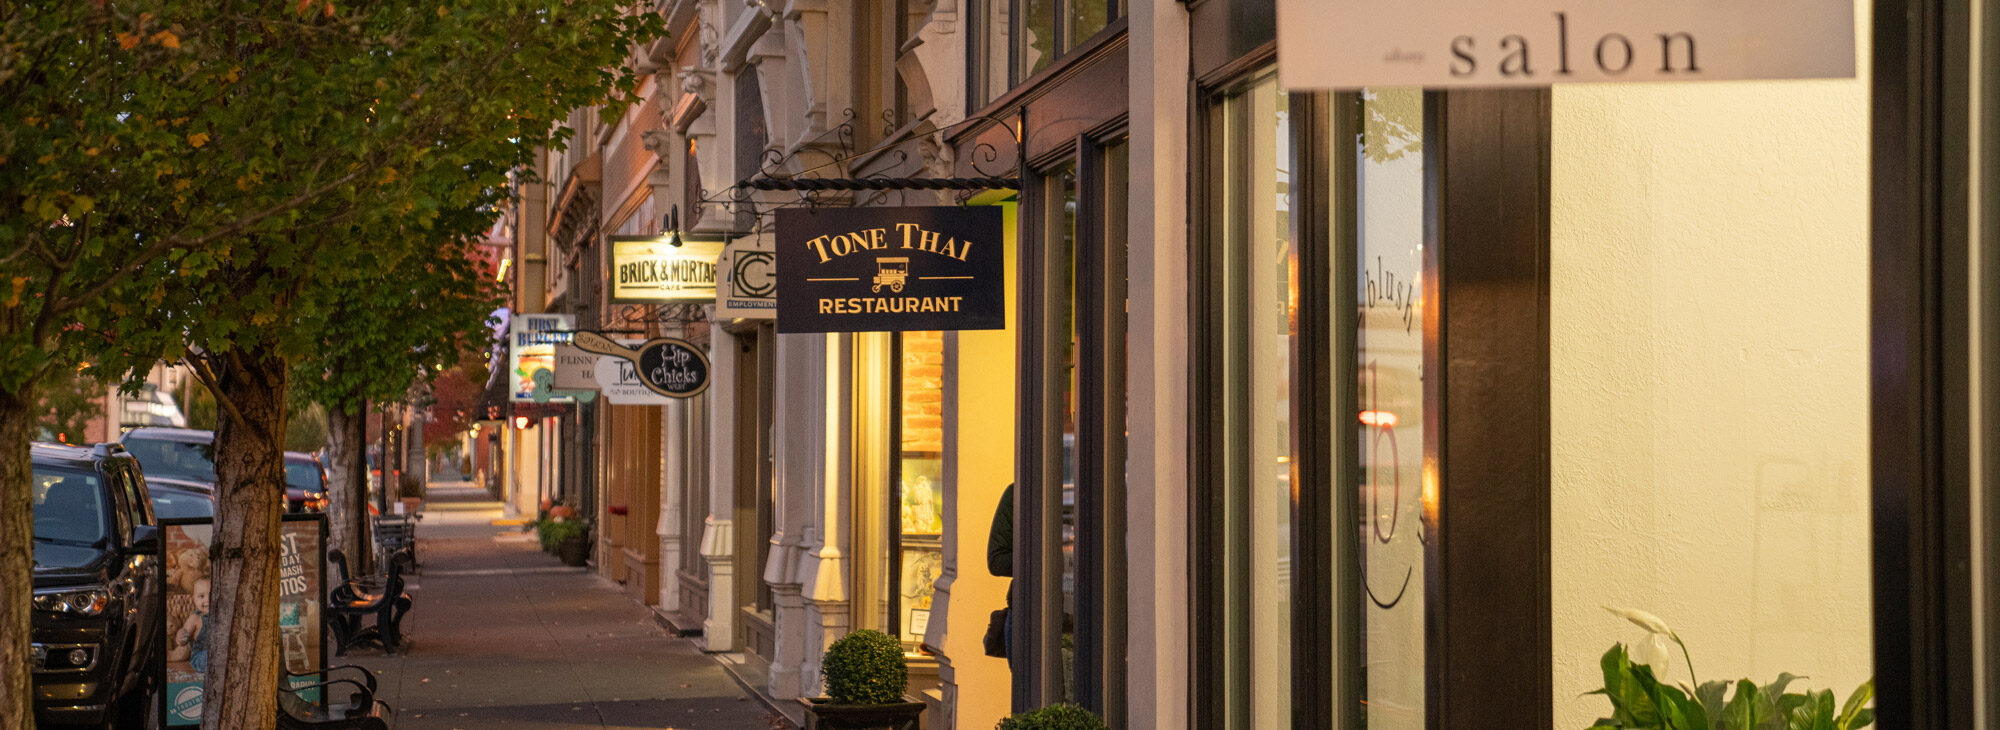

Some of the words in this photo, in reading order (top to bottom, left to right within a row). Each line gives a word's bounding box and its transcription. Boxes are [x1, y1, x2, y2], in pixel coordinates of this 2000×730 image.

[1448, 11, 1702, 78] salon
[620, 260, 658, 284] BRICK
[659, 260, 668, 282] &
[659, 283, 681, 292] CAFE
[1366, 256, 1412, 336] blush
[818, 296, 963, 314] RESTAURANT
[527, 318, 559, 332] FIRST
[560, 356, 592, 365] FLINN
[661, 344, 689, 368] Hip
[651, 366, 697, 386] Chicks
[281, 554, 300, 567] DAY
[280, 565, 303, 578] MASH
